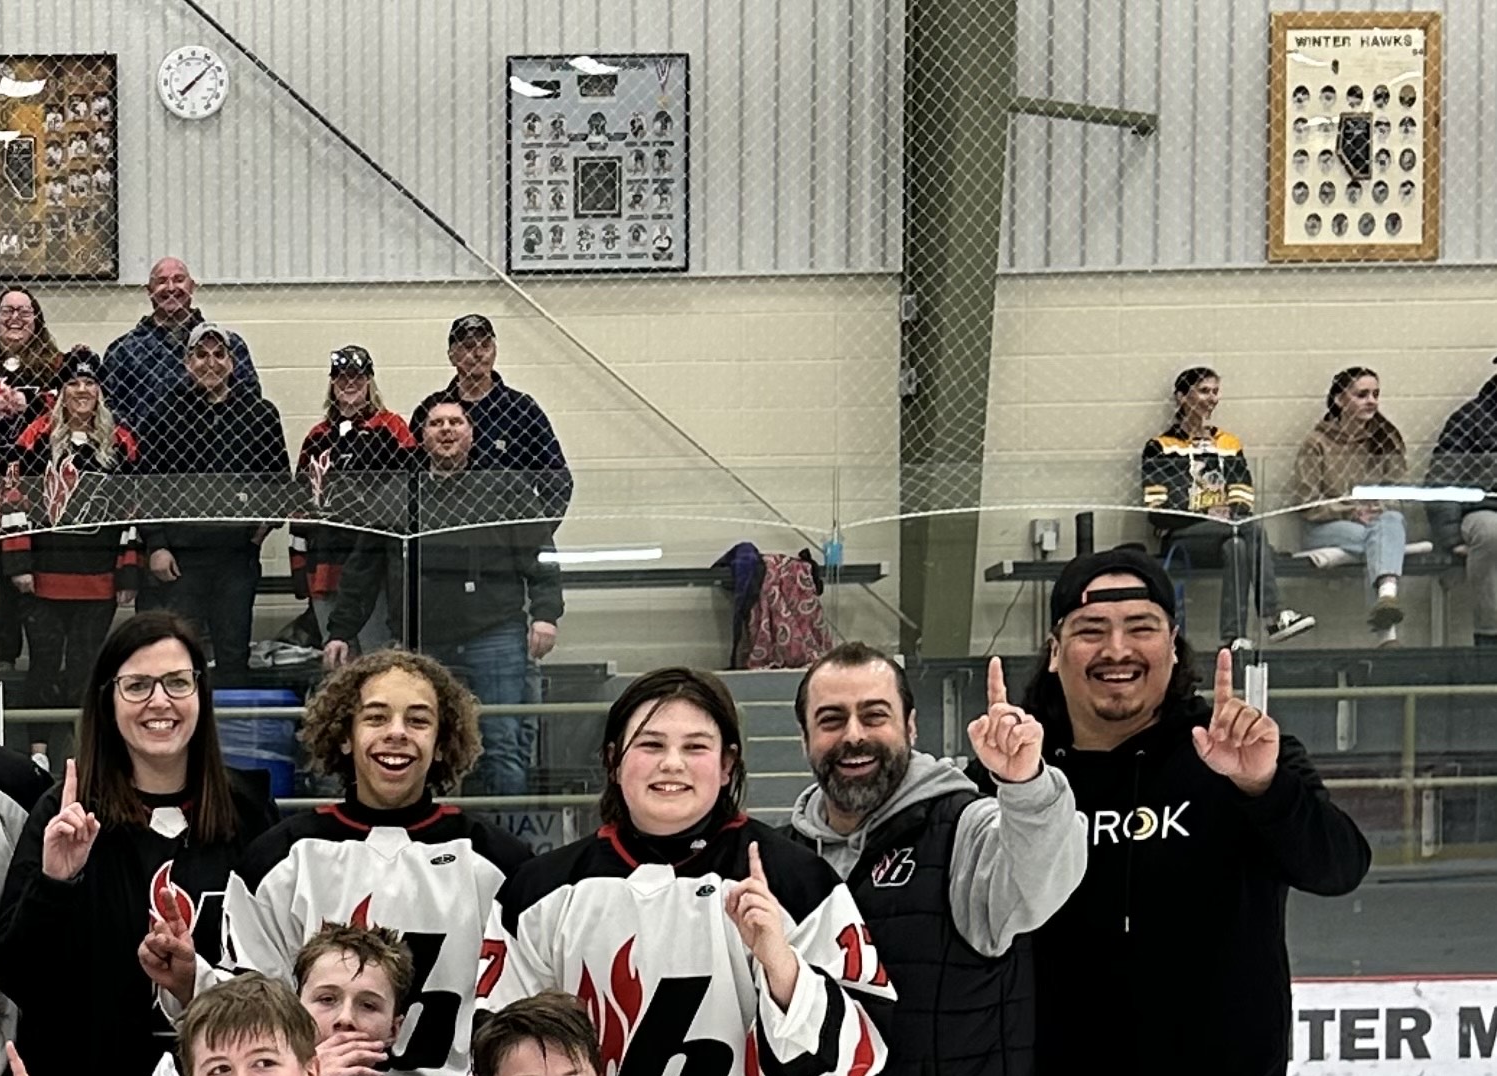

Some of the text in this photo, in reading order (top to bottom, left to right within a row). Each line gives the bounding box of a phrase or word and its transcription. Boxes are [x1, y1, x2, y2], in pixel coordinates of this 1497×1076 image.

[1294, 34, 1412, 47] WINTER HAWKS
[1076, 801, 1191, 846] ROK
[1288, 1006, 1432, 1061] TER
